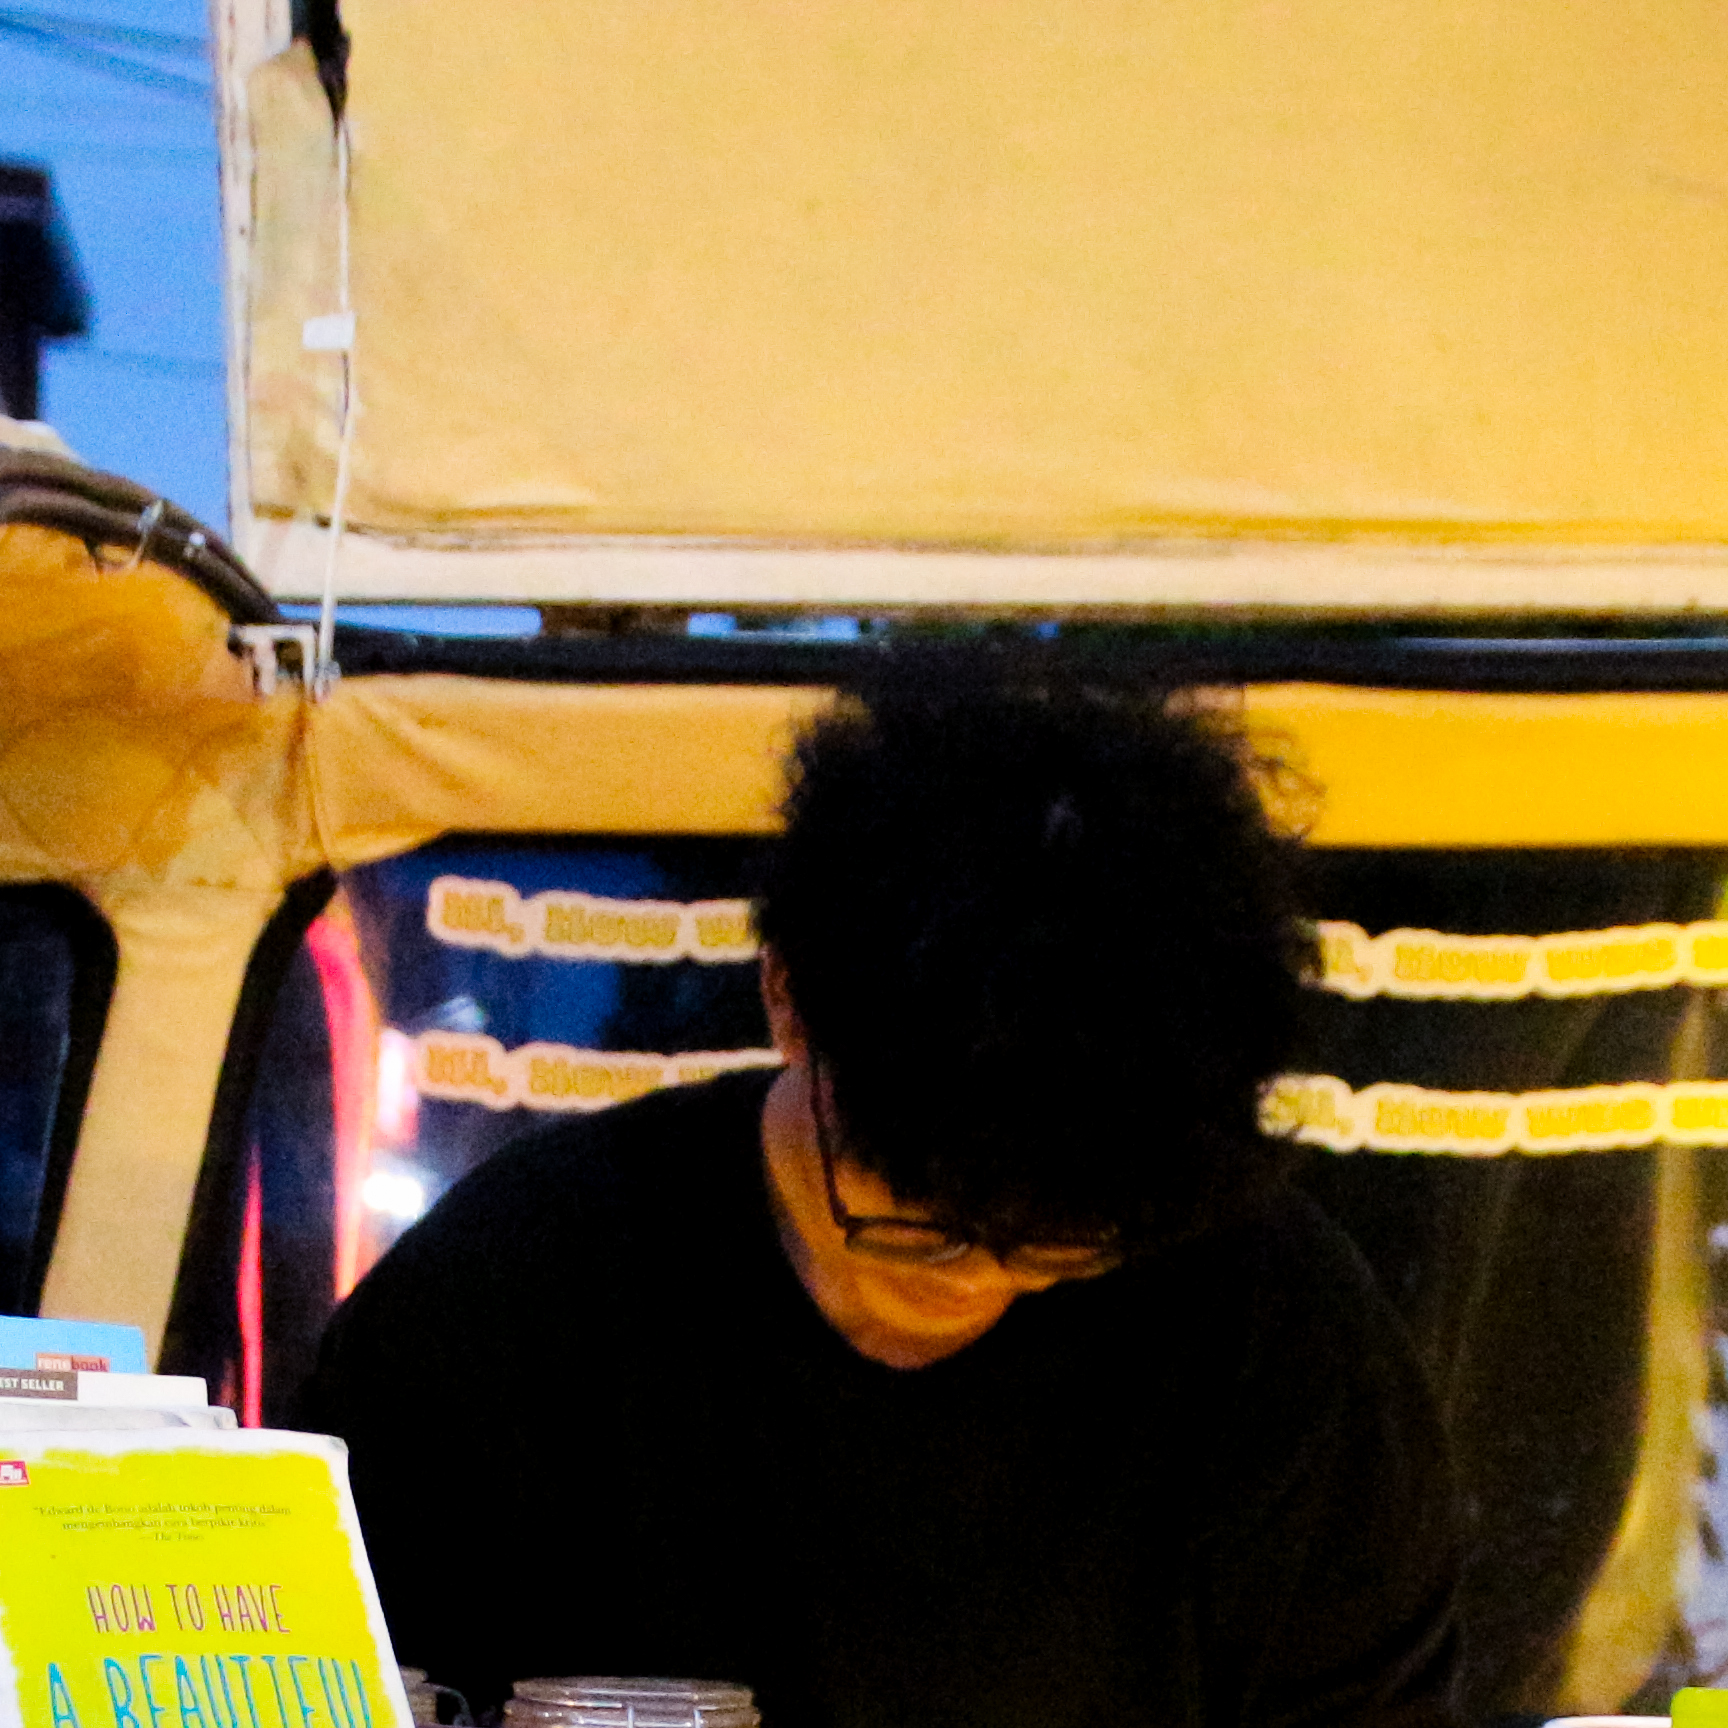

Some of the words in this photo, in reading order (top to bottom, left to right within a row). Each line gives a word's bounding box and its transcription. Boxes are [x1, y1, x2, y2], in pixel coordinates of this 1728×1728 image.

[21, 1378, 64, 1391] SELLER
[87, 1583, 157, 1633] HOW
[165, 1583, 204, 1632] TO
[213, 1583, 290, 1633] HAVE
